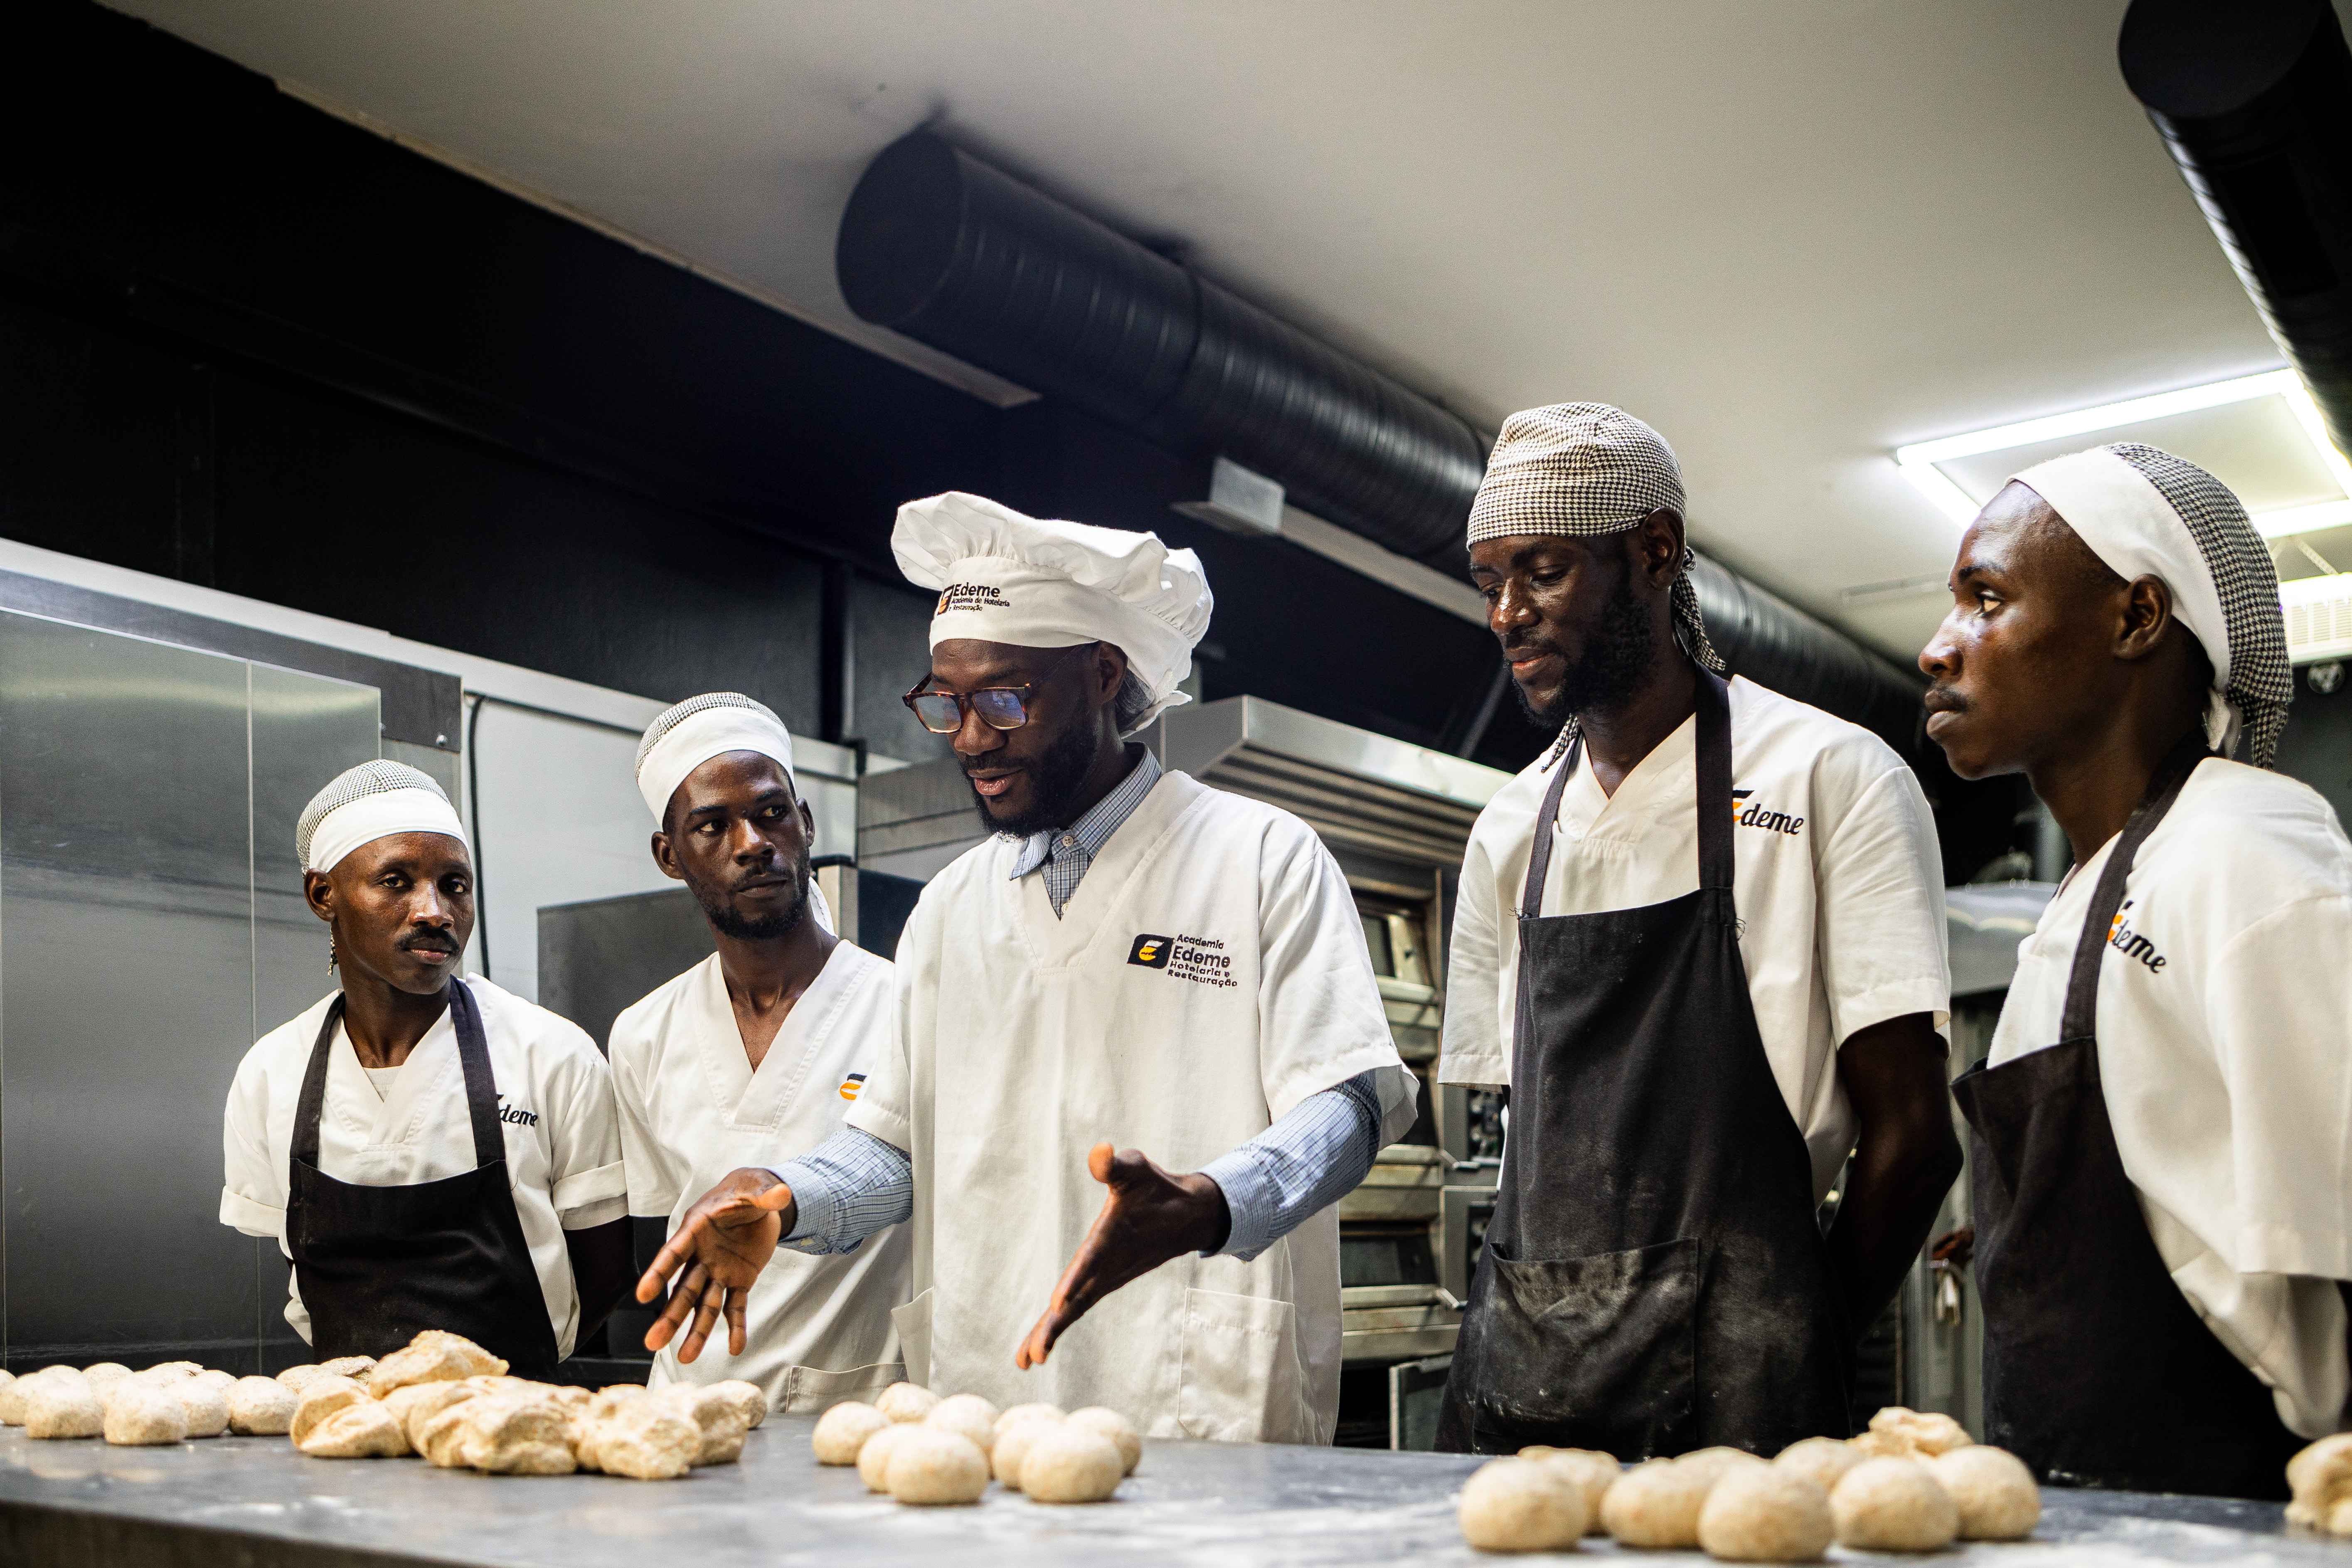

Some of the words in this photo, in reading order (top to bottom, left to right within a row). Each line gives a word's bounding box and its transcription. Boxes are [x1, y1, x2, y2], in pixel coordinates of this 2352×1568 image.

[953, 582, 1000, 598] Edeme
[984, 598, 1010, 607] Hotelaria
[1177, 934, 1224, 950] Academia
[1172, 945, 1231, 968] Edeme
[1170, 960, 1221, 977] Hotelaria
[1167, 969, 1238, 988] Restauração
